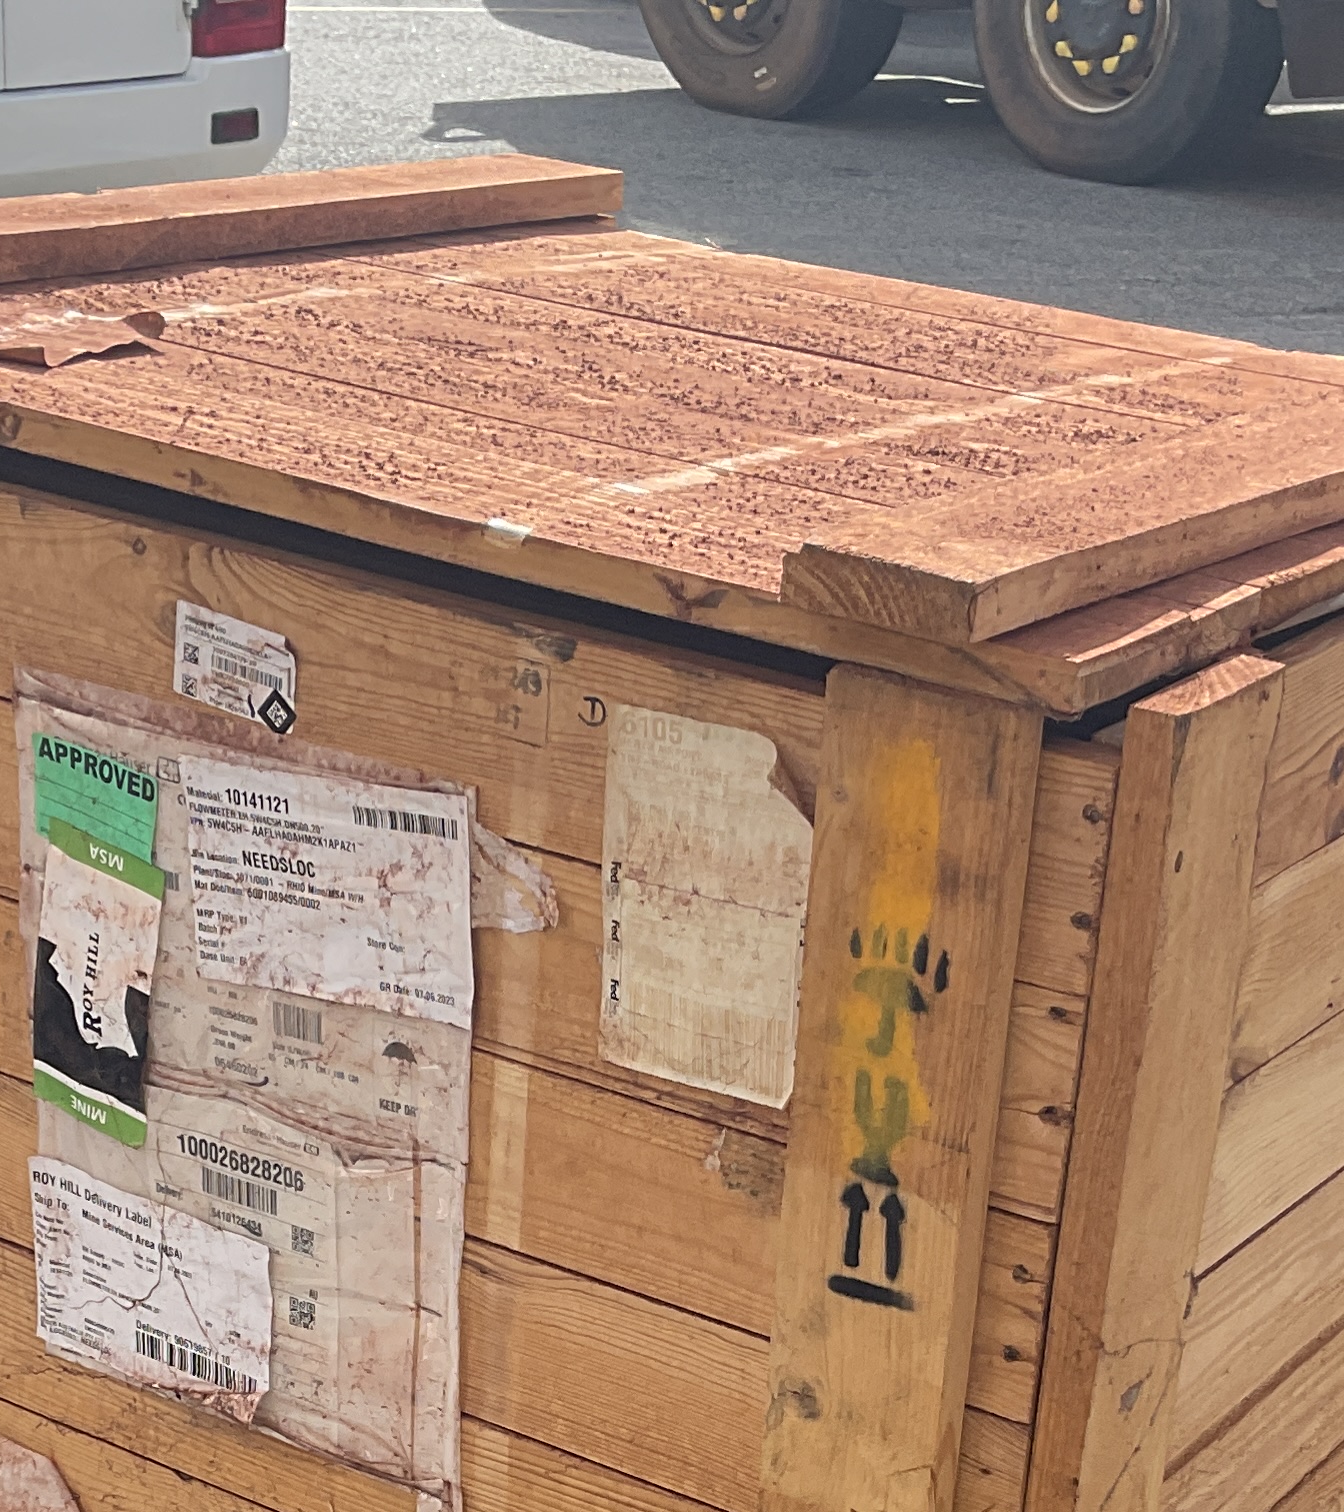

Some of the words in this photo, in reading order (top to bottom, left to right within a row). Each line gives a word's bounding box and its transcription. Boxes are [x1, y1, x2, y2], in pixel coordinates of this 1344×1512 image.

[38, 737, 156, 803] APPROVED
[225, 788, 290, 814] 10141121
[89, 843, 124, 872] MSA
[242, 850, 316, 878] NEEDSLOC
[84, 931, 101, 981] HILL
[379, 981, 391, 993] GR
[82, 985, 103, 1037] ROY
[70, 1095, 107, 1125] MINE
[379, 1098, 402, 1114] KEEP
[404, 1104, 419, 1118] DR
[177, 1133, 305, 1192] 100026828206
[32, 1171, 56, 1187] ROY
[60, 1178, 82, 1198] HILL
[84, 1188, 122, 1217] Delivery
[125, 1207, 152, 1229] Label
[34, 1192, 53, 1208] Ship
[135, 1234, 155, 1250] Area
